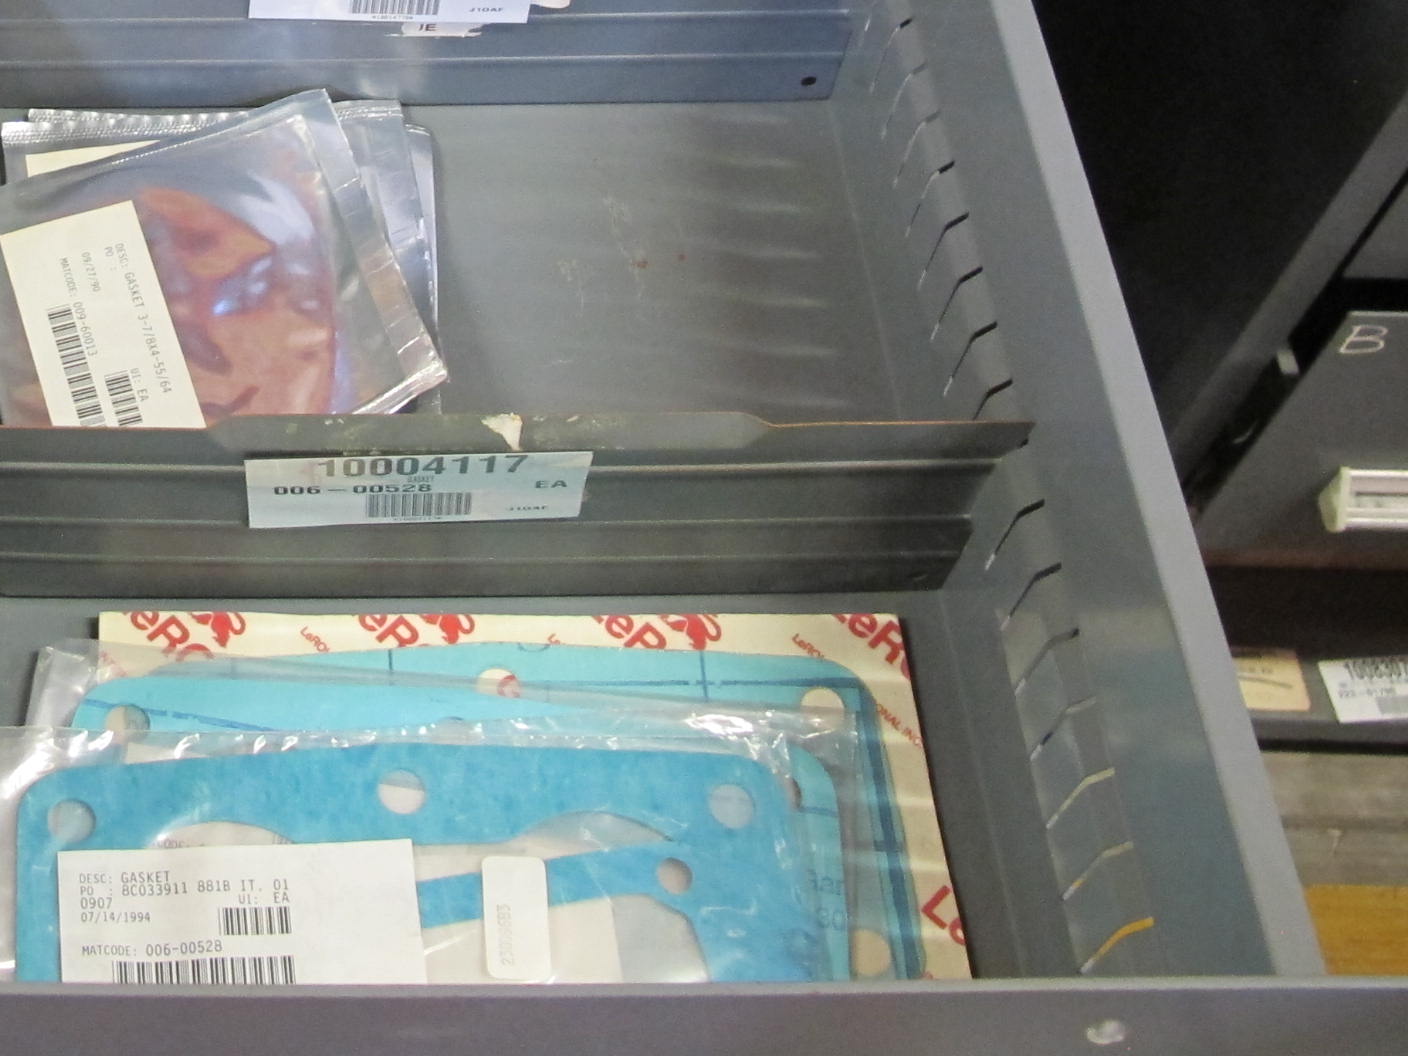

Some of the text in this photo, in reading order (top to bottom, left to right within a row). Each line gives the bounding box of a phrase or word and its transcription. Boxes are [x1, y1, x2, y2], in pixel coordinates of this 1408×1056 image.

[124, 271, 145, 309] GASKET
[73, 301, 99, 358] 009-60013
[136, 388, 150, 402] EA
[317, 454, 529, 478] 10004117
[534, 479, 568, 490] EA
[79, 870, 171, 884] DESC: GASKET
[80, 885, 93, 897] PO
[80, 896, 113, 910] 0907
[273, 891, 291, 904] EA
[80, 911, 151, 923] 07/14/1994
[81, 939, 224, 957] MATCODE: 006-00528
